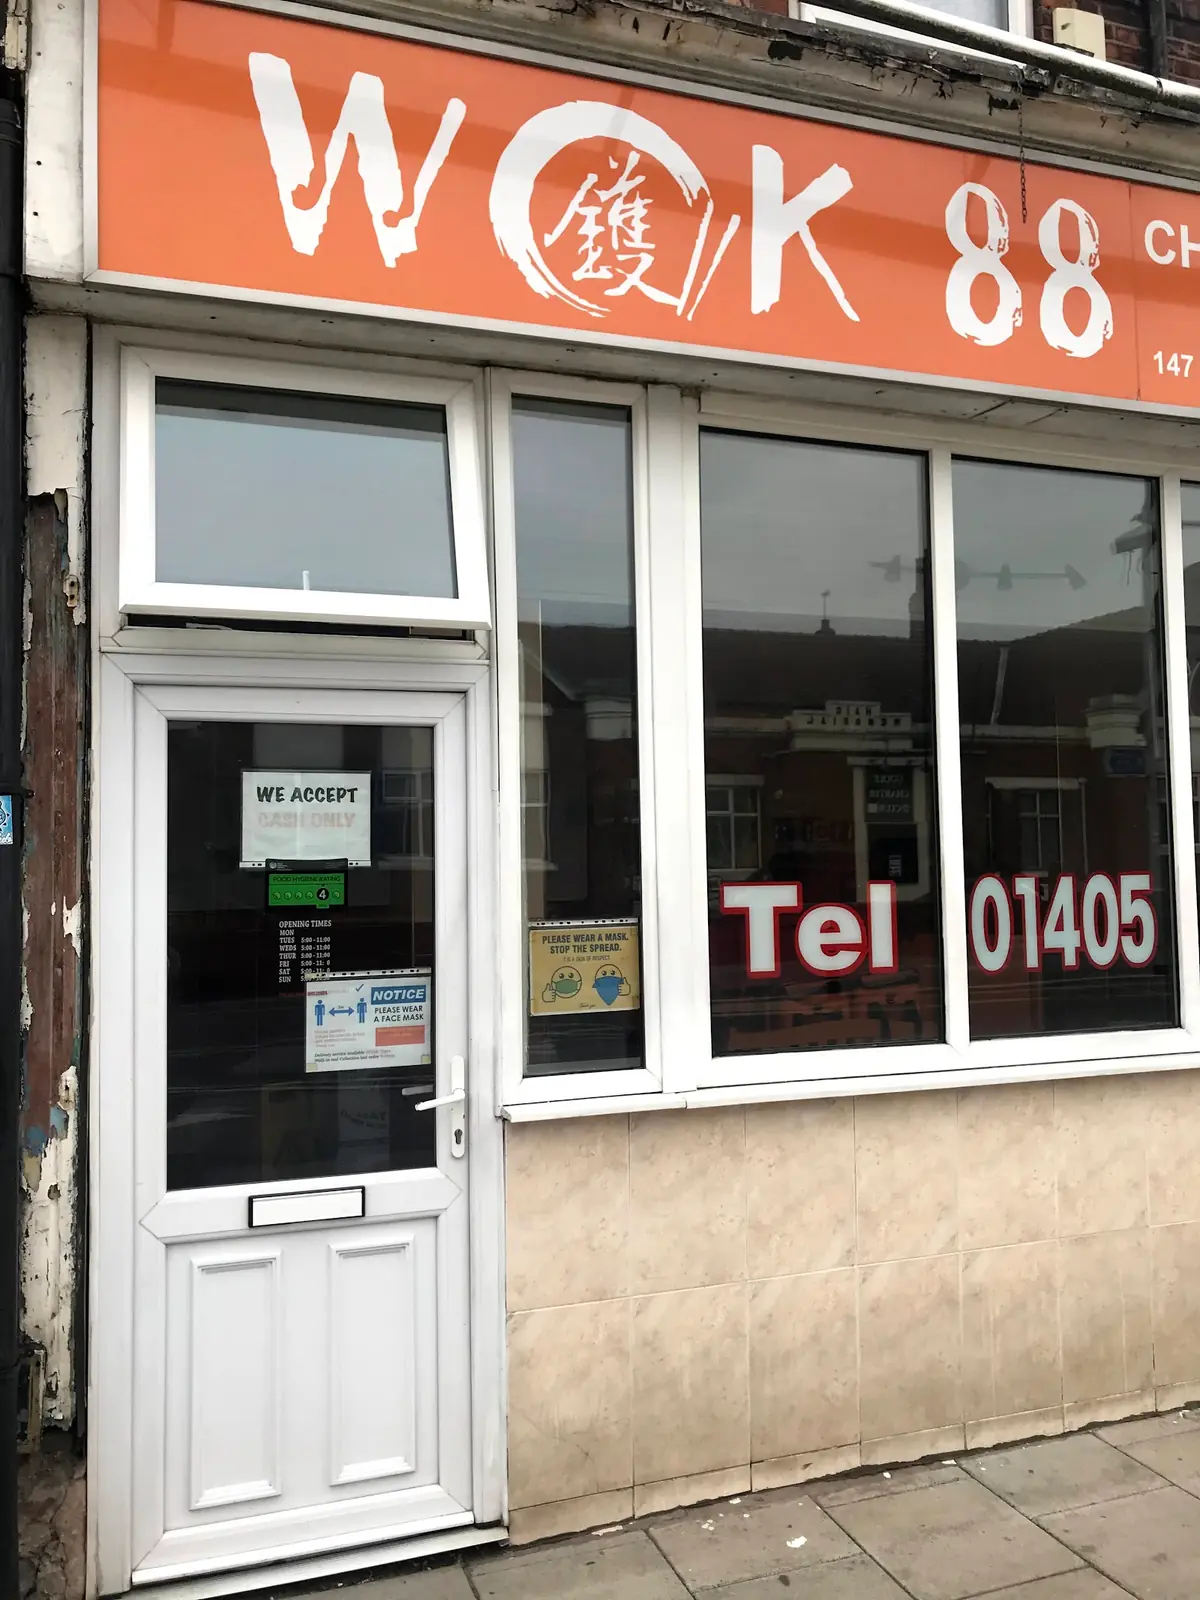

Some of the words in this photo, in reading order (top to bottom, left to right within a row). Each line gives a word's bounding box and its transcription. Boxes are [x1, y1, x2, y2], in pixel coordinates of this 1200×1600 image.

[248, 52, 860, 322] WOK
[944, 182, 1113, 358] 88
[1153, 350, 1194, 378] 147
[256, 786, 285, 803] WE
[290, 786, 358, 803] ACCEPT
[258, 812, 303, 829] CASH
[310, 812, 356, 828] ONLY
[318, 888, 327, 900] 4
[279, 920, 310, 928] OPENING
[720, 879, 899, 979] Tel
[969, 871, 1157, 977] 01405
[542, 935, 571, 944] PLEASE
[573, 934, 595, 943] WEAR
[598, 934, 604, 942] A
[605, 933, 629, 942] MASK.
[550, 945, 570, 954] STOP
[572, 945, 588, 953] THE
[590, 944, 622, 953] SPREAD.
[373, 989, 425, 1001] NOTICE
[375, 1006, 400, 1014] PLEASE
